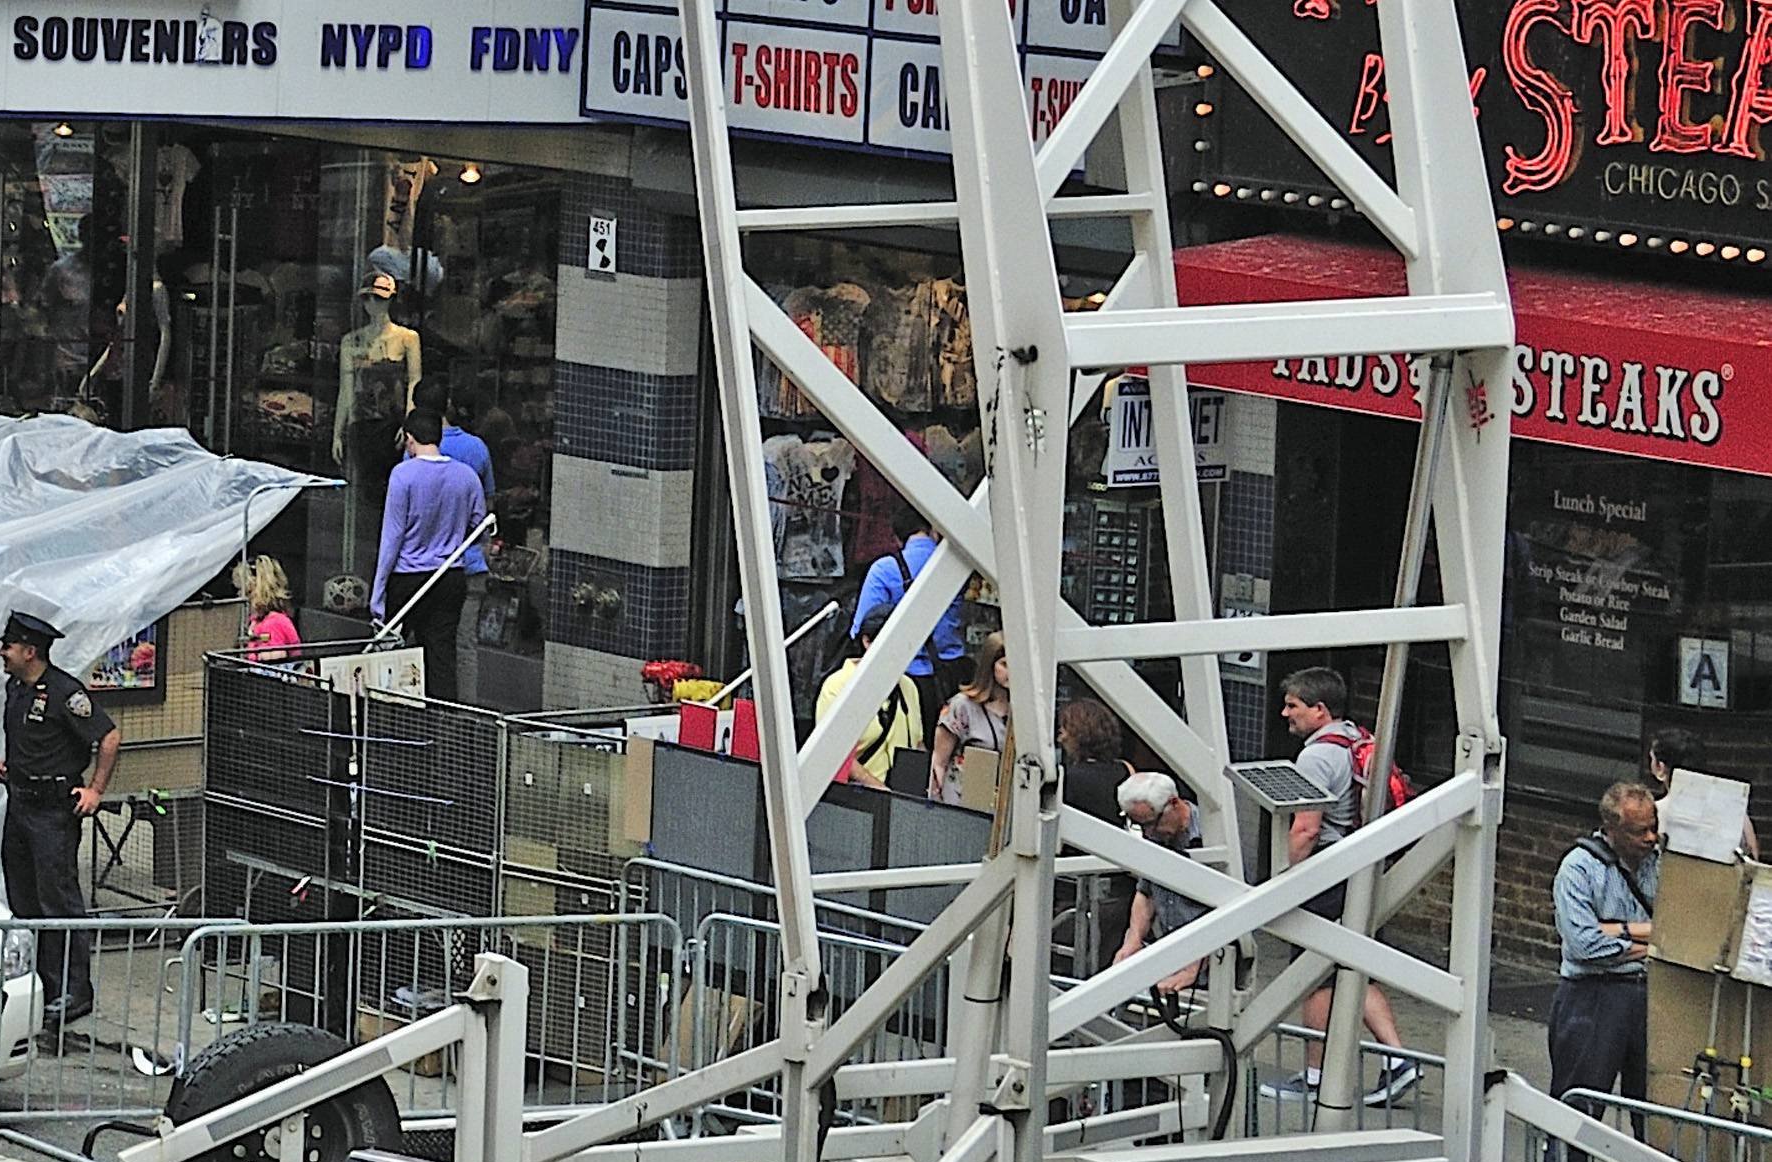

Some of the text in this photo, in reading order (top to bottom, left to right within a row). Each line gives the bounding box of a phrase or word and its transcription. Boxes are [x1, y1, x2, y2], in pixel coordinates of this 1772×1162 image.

[321, 23, 433, 70] NYPD
[470, 26, 579, 73] FDNY
[732, 43, 858, 118] T-SHIRTS
[1604, 161, 1741, 206] CHICAGO
[592, 221, 611, 236] 451
[1511, 345, 1721, 443] STEAKS
[1553, 490, 1647, 522] Lunch Special
[1529, 561, 1553, 583] Strip
[1556, 566, 1583, 583] Steak
[1600, 574, 1639, 599] Cowboy
[1642, 583, 1670, 600] Steak
[1559, 587, 1592, 605] Potato
[1608, 595, 1630, 612] Rice
[1560, 607, 1628, 632] Garden Salad
[1561, 627, 1625, 651] Garlic Bread
[1689, 653, 1722, 691] A
